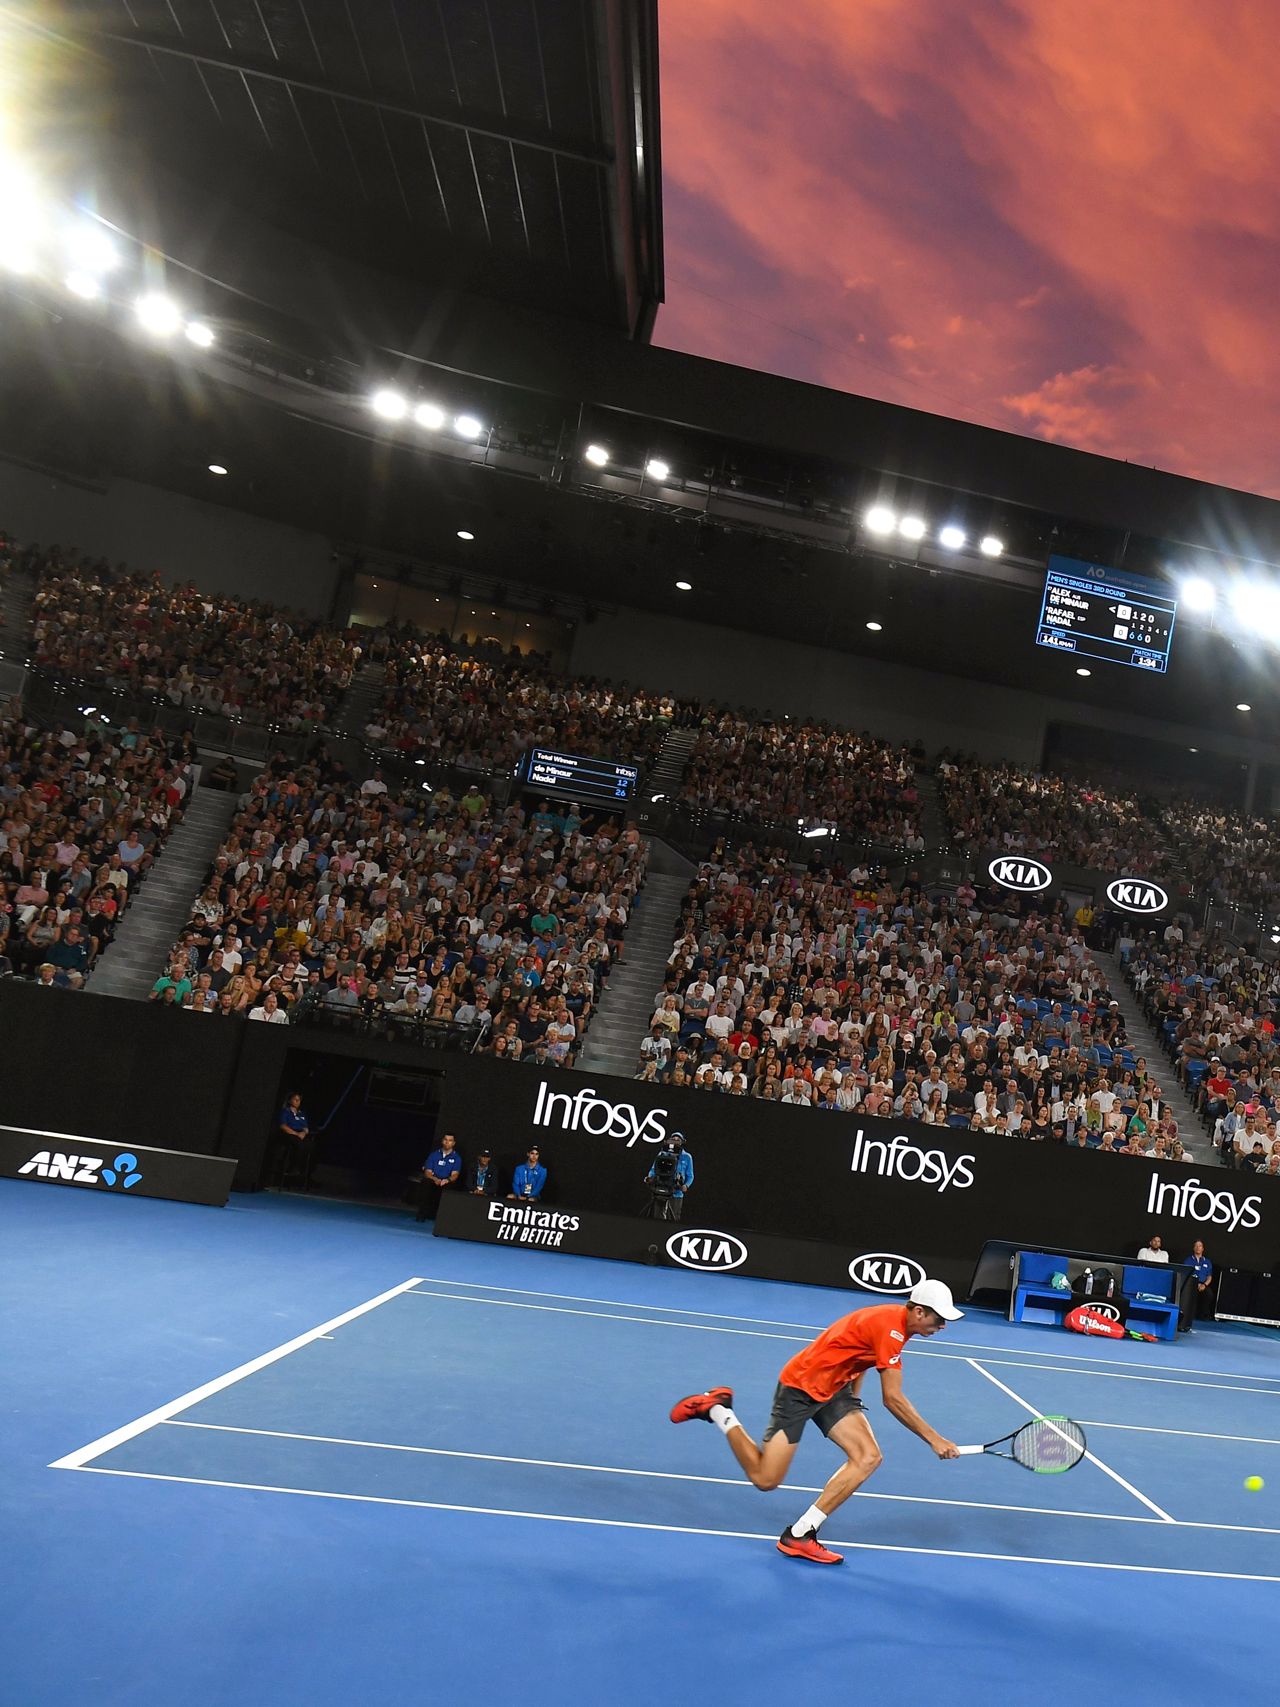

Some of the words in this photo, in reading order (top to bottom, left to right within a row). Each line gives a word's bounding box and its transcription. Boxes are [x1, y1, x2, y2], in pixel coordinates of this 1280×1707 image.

[1051, 587, 1071, 598] ALEX
[1069, 579, 1093, 591] SINGLES
[1093, 584, 1105, 593] 3RD
[1105, 586, 1126, 598] ROUND
[1050, 595, 1061, 604] DE
[1061, 598, 1089, 610] MINAUR
[1048, 606, 1076, 620] RAFAEL
[1132, 611, 1138, 620] 1
[1140, 612, 1146, 622] 2
[1148, 614, 1155, 624] 0
[1046, 614, 1071, 627] NADAL
[1043, 635, 1058, 646] 141
[1129, 631, 1135, 640] 6
[1137, 633, 1143, 642] 6
[1144, 634, 1151, 644] 0
[1138, 657, 1156, 668] 1:34
[532, 773, 556, 784] Nadal
[534, 765, 545, 773] de
[545, 767, 573, 778] Minaur
[617, 779, 628, 787] 12
[615, 789, 626, 797] 26
[533, 1081, 668, 1148] Infosys
[17, 1151, 104, 1184] ANZ
[850, 1129, 976, 1193] Infosys
[1147, 1172, 1262, 1232] Infosys
[487, 1201, 580, 1231] Emirates
[496, 1223, 520, 1241] FLY
[519, 1226, 564, 1247] BETTER
[679, 1235, 733, 1264] KIA
[862, 1260, 913, 1287] KIA
